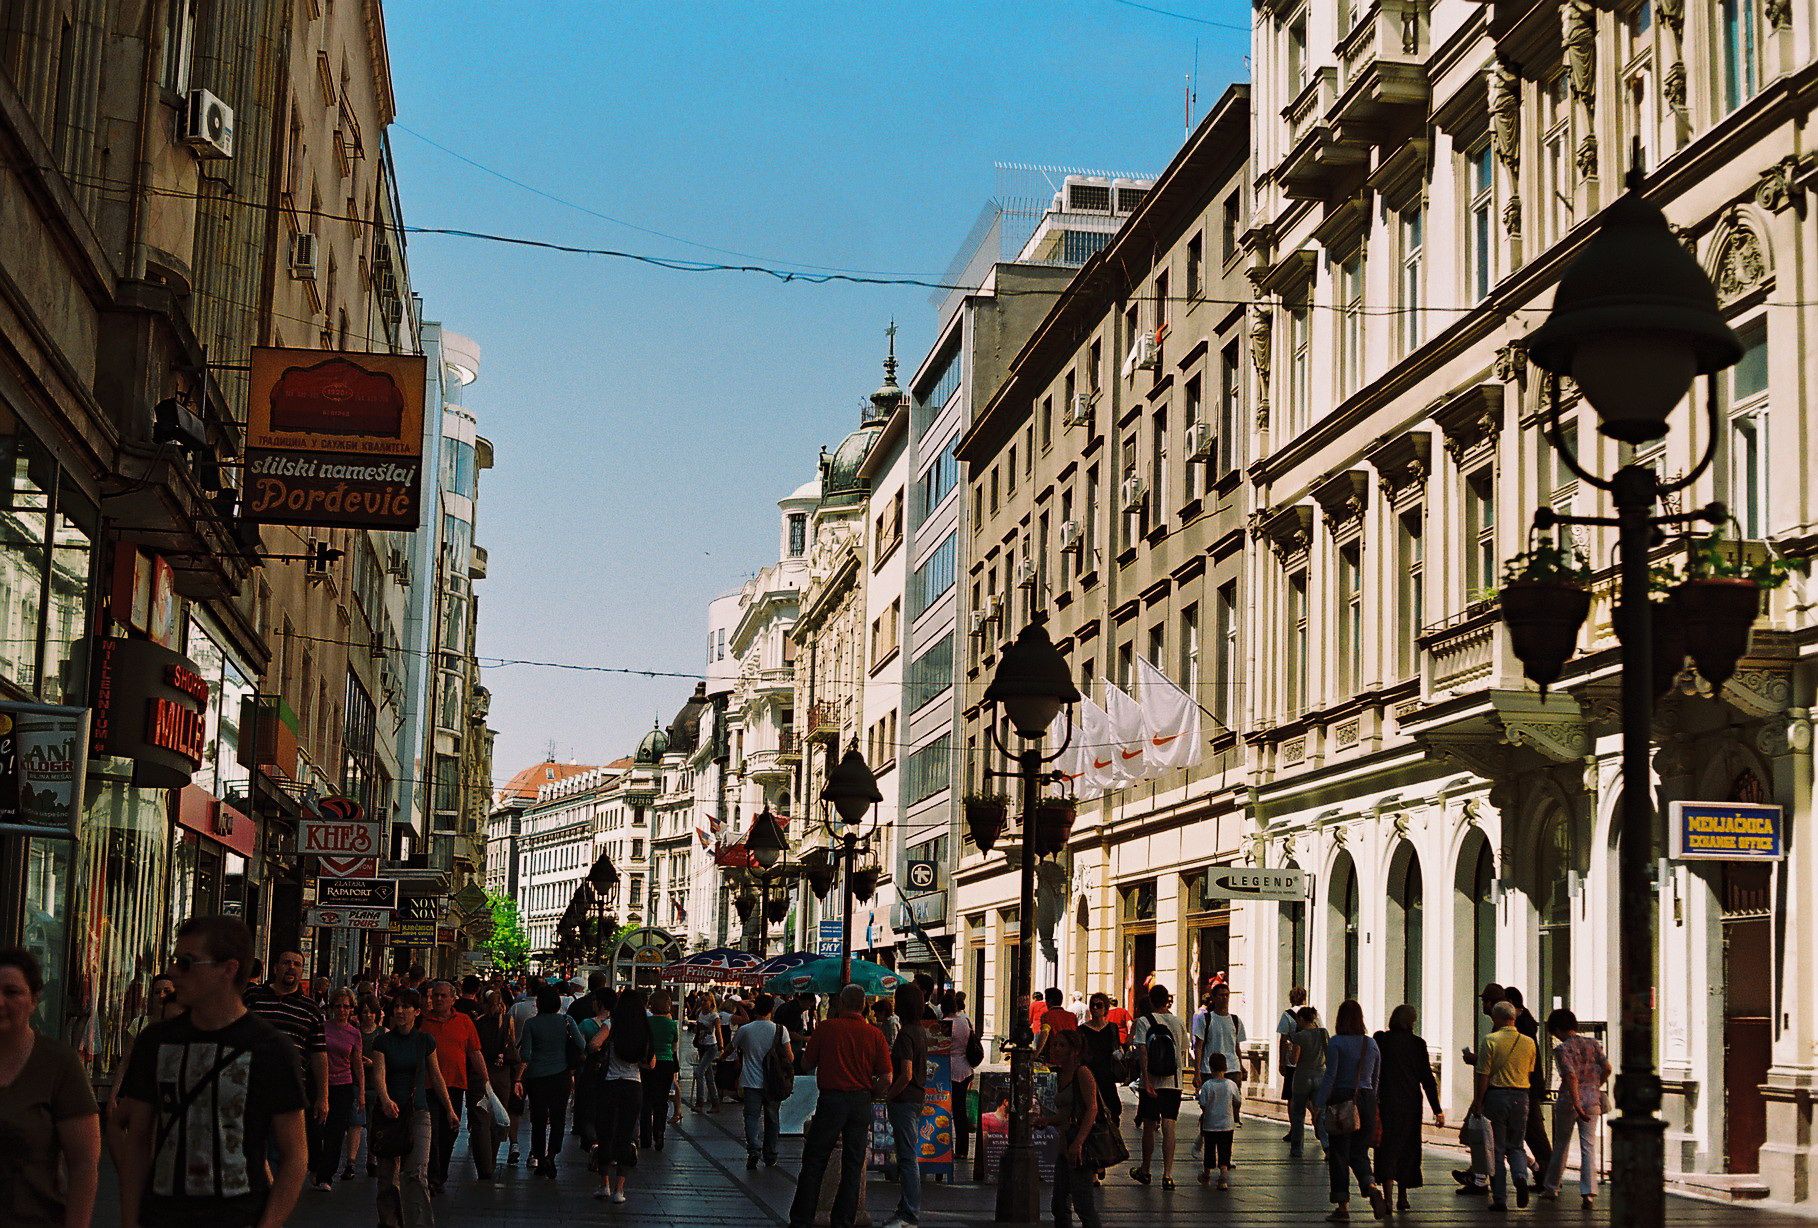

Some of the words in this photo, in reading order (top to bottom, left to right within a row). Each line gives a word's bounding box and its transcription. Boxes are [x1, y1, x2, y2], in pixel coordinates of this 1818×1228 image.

[257, 435, 307, 448] ТРАДИЦИЈА
[320, 438, 359, 450] СЛУЖБИ
[361, 440, 410, 452] КВАЛИТЕТА
[251, 456, 319, 477] stilski
[319, 463, 416, 487] nameštaj
[251, 478, 411, 516] Đorđević
[152, 696, 205, 761] MILLE
[1688, 813, 1773, 834] MENJAČNICA
[1738, 836, 1774, 850] OFFICE
[333, 880, 367, 888] ZLATARA
[327, 887, 373, 897] RAPAPORT
[410, 898, 436, 908] NOA
[348, 910, 381, 919] PLANA
[410, 909, 436, 919] NOA
[348, 919, 380, 928] TOURS
[820, 943, 841, 952] SKY
[686, 965, 724, 979] Frikom
